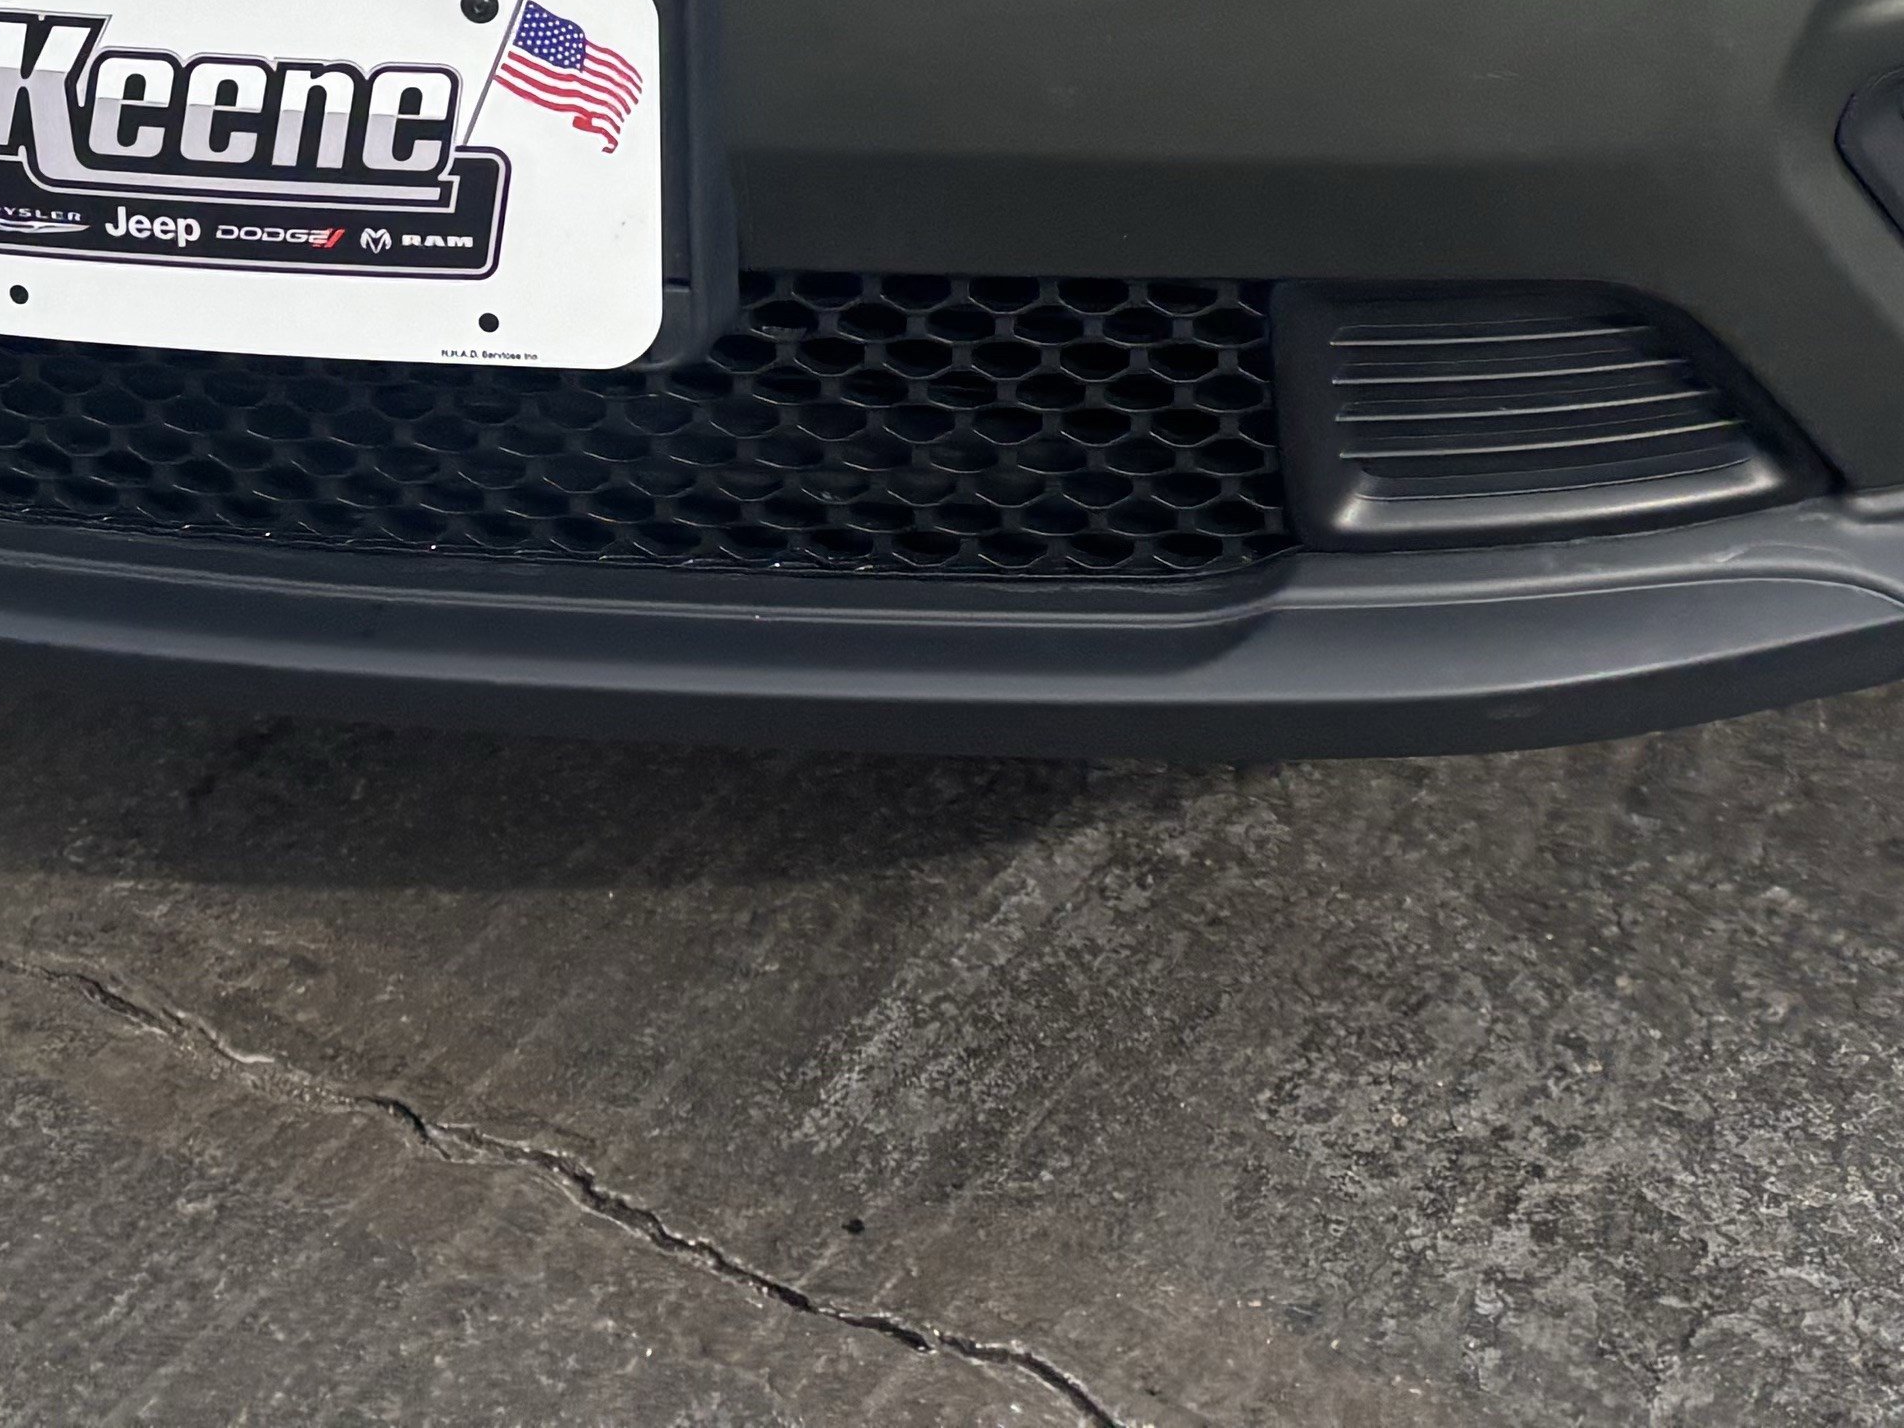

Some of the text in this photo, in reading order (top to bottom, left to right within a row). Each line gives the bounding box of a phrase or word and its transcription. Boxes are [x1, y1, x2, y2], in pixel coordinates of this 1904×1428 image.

[105, 206, 201, 248] Jeep
[215, 224, 332, 246] DODGE
[401, 234, 474, 248] RAM
